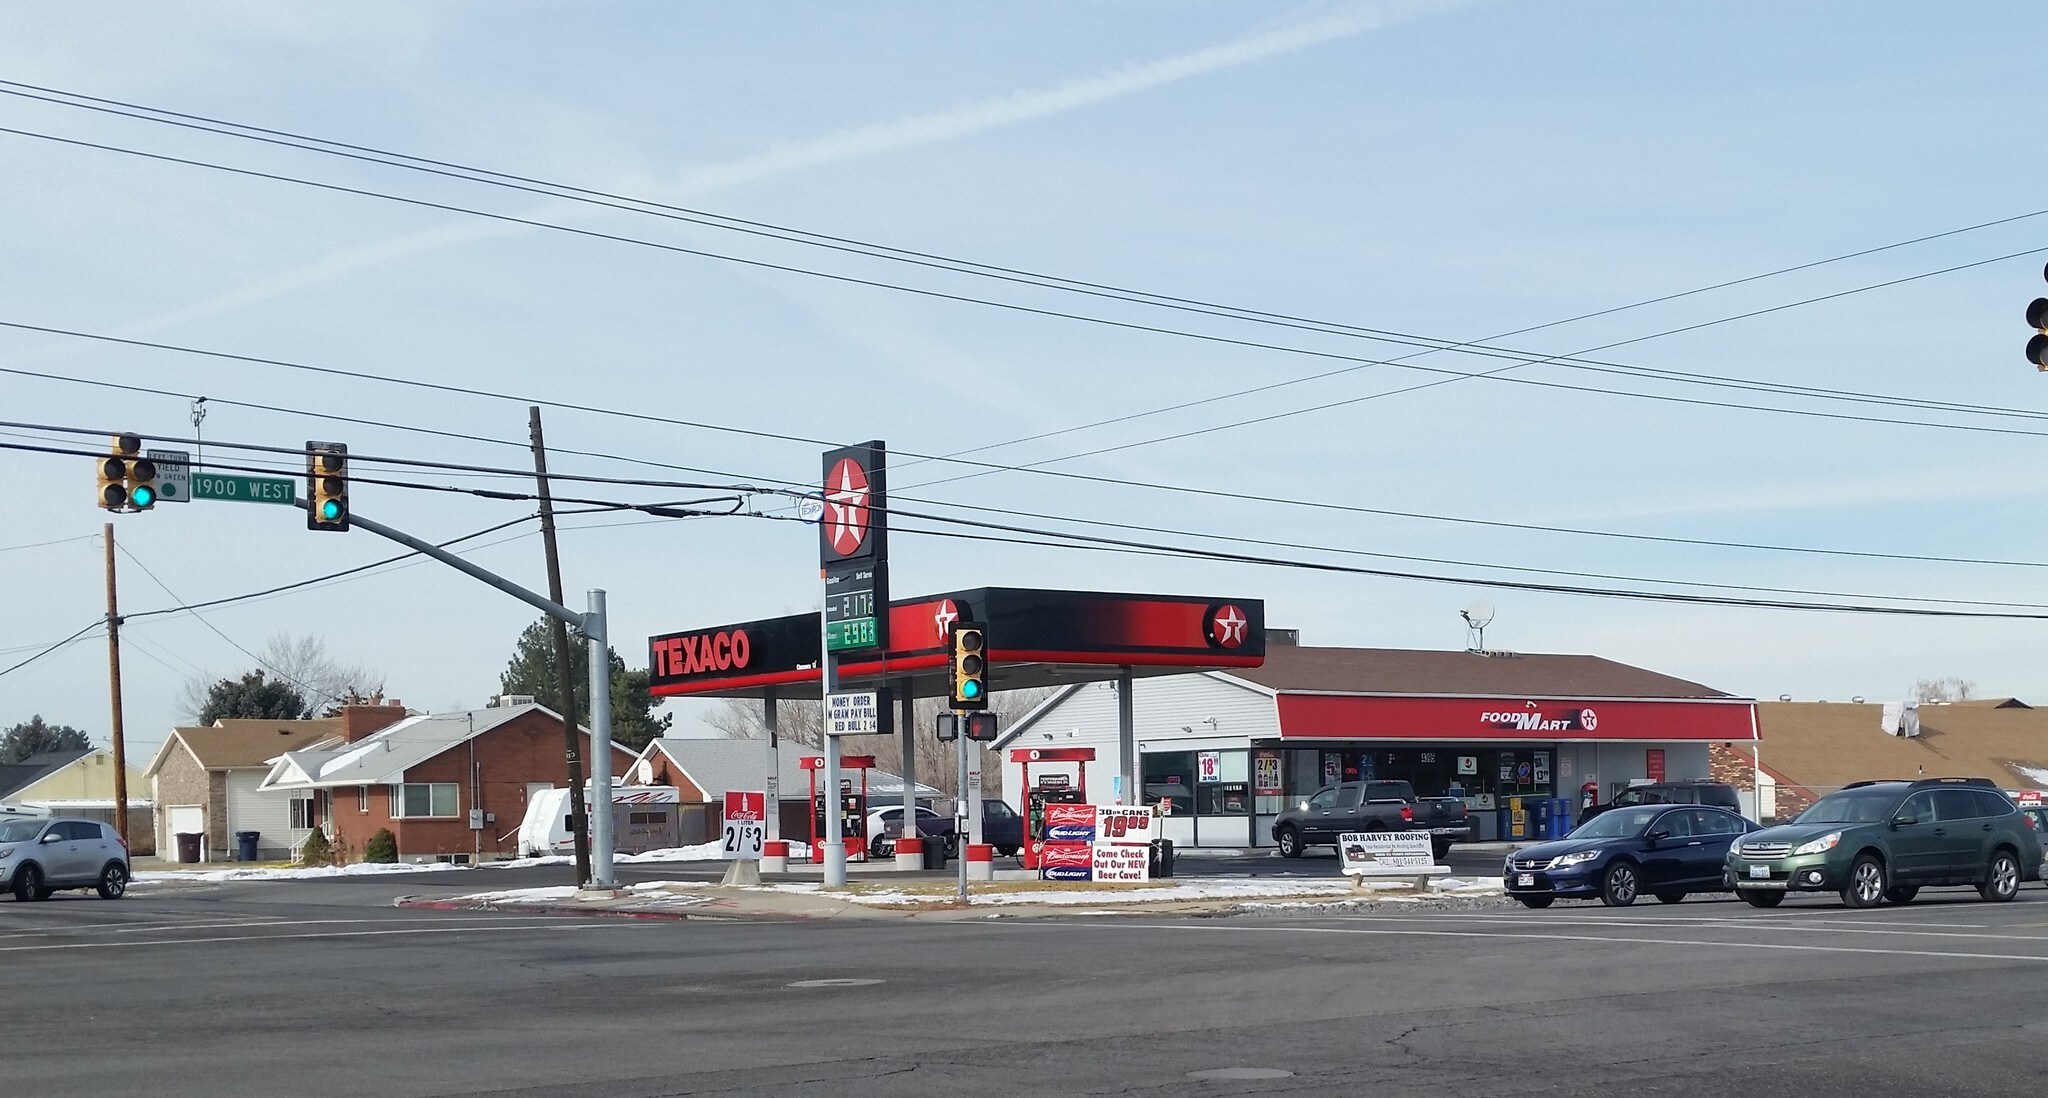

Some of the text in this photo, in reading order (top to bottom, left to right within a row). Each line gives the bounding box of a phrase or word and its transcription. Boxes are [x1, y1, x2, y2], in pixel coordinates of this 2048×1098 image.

[158, 462, 180, 472] YIELD
[196, 478, 291, 499] 1900 WEST
[653, 630, 750, 677] TEXACO
[832, 696, 870, 707] MONEY ORDER
[834, 709, 849, 719] GRAM
[851, 709, 862, 718] PAY
[864, 708, 876, 718] BILL
[835, 721, 845, 731] RED
[848, 721, 861, 731] BULL
[864, 721, 866, 730] 2
[1480, 712, 1571, 730] FOOD MART
[1258, 760, 1278, 770] 2/$3
[1050, 808, 1094, 822] Budweiser
[726, 826, 762, 852] 2/$3
[1046, 850, 1090, 862] Budweiser
[1096, 849, 1144, 858] Come Check
[1098, 870, 1140, 879] Beer Cave!
